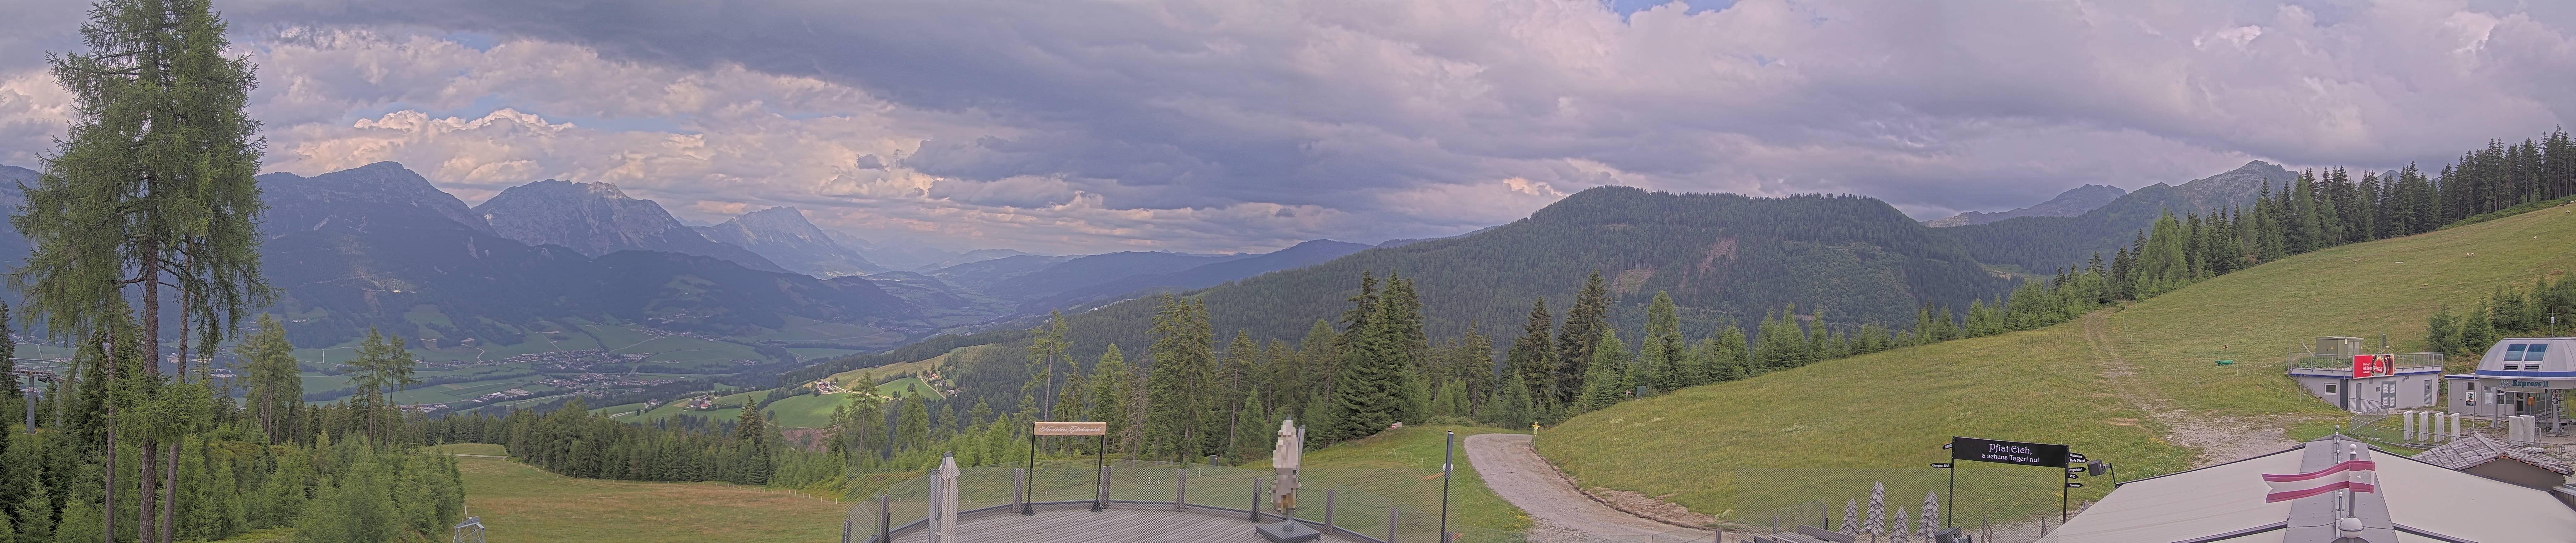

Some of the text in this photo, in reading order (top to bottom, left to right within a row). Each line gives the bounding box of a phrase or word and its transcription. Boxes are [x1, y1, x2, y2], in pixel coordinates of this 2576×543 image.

[2512, 380, 2542, 388] Express
[1989, 443, 2032, 455] Pfiat Eich,
